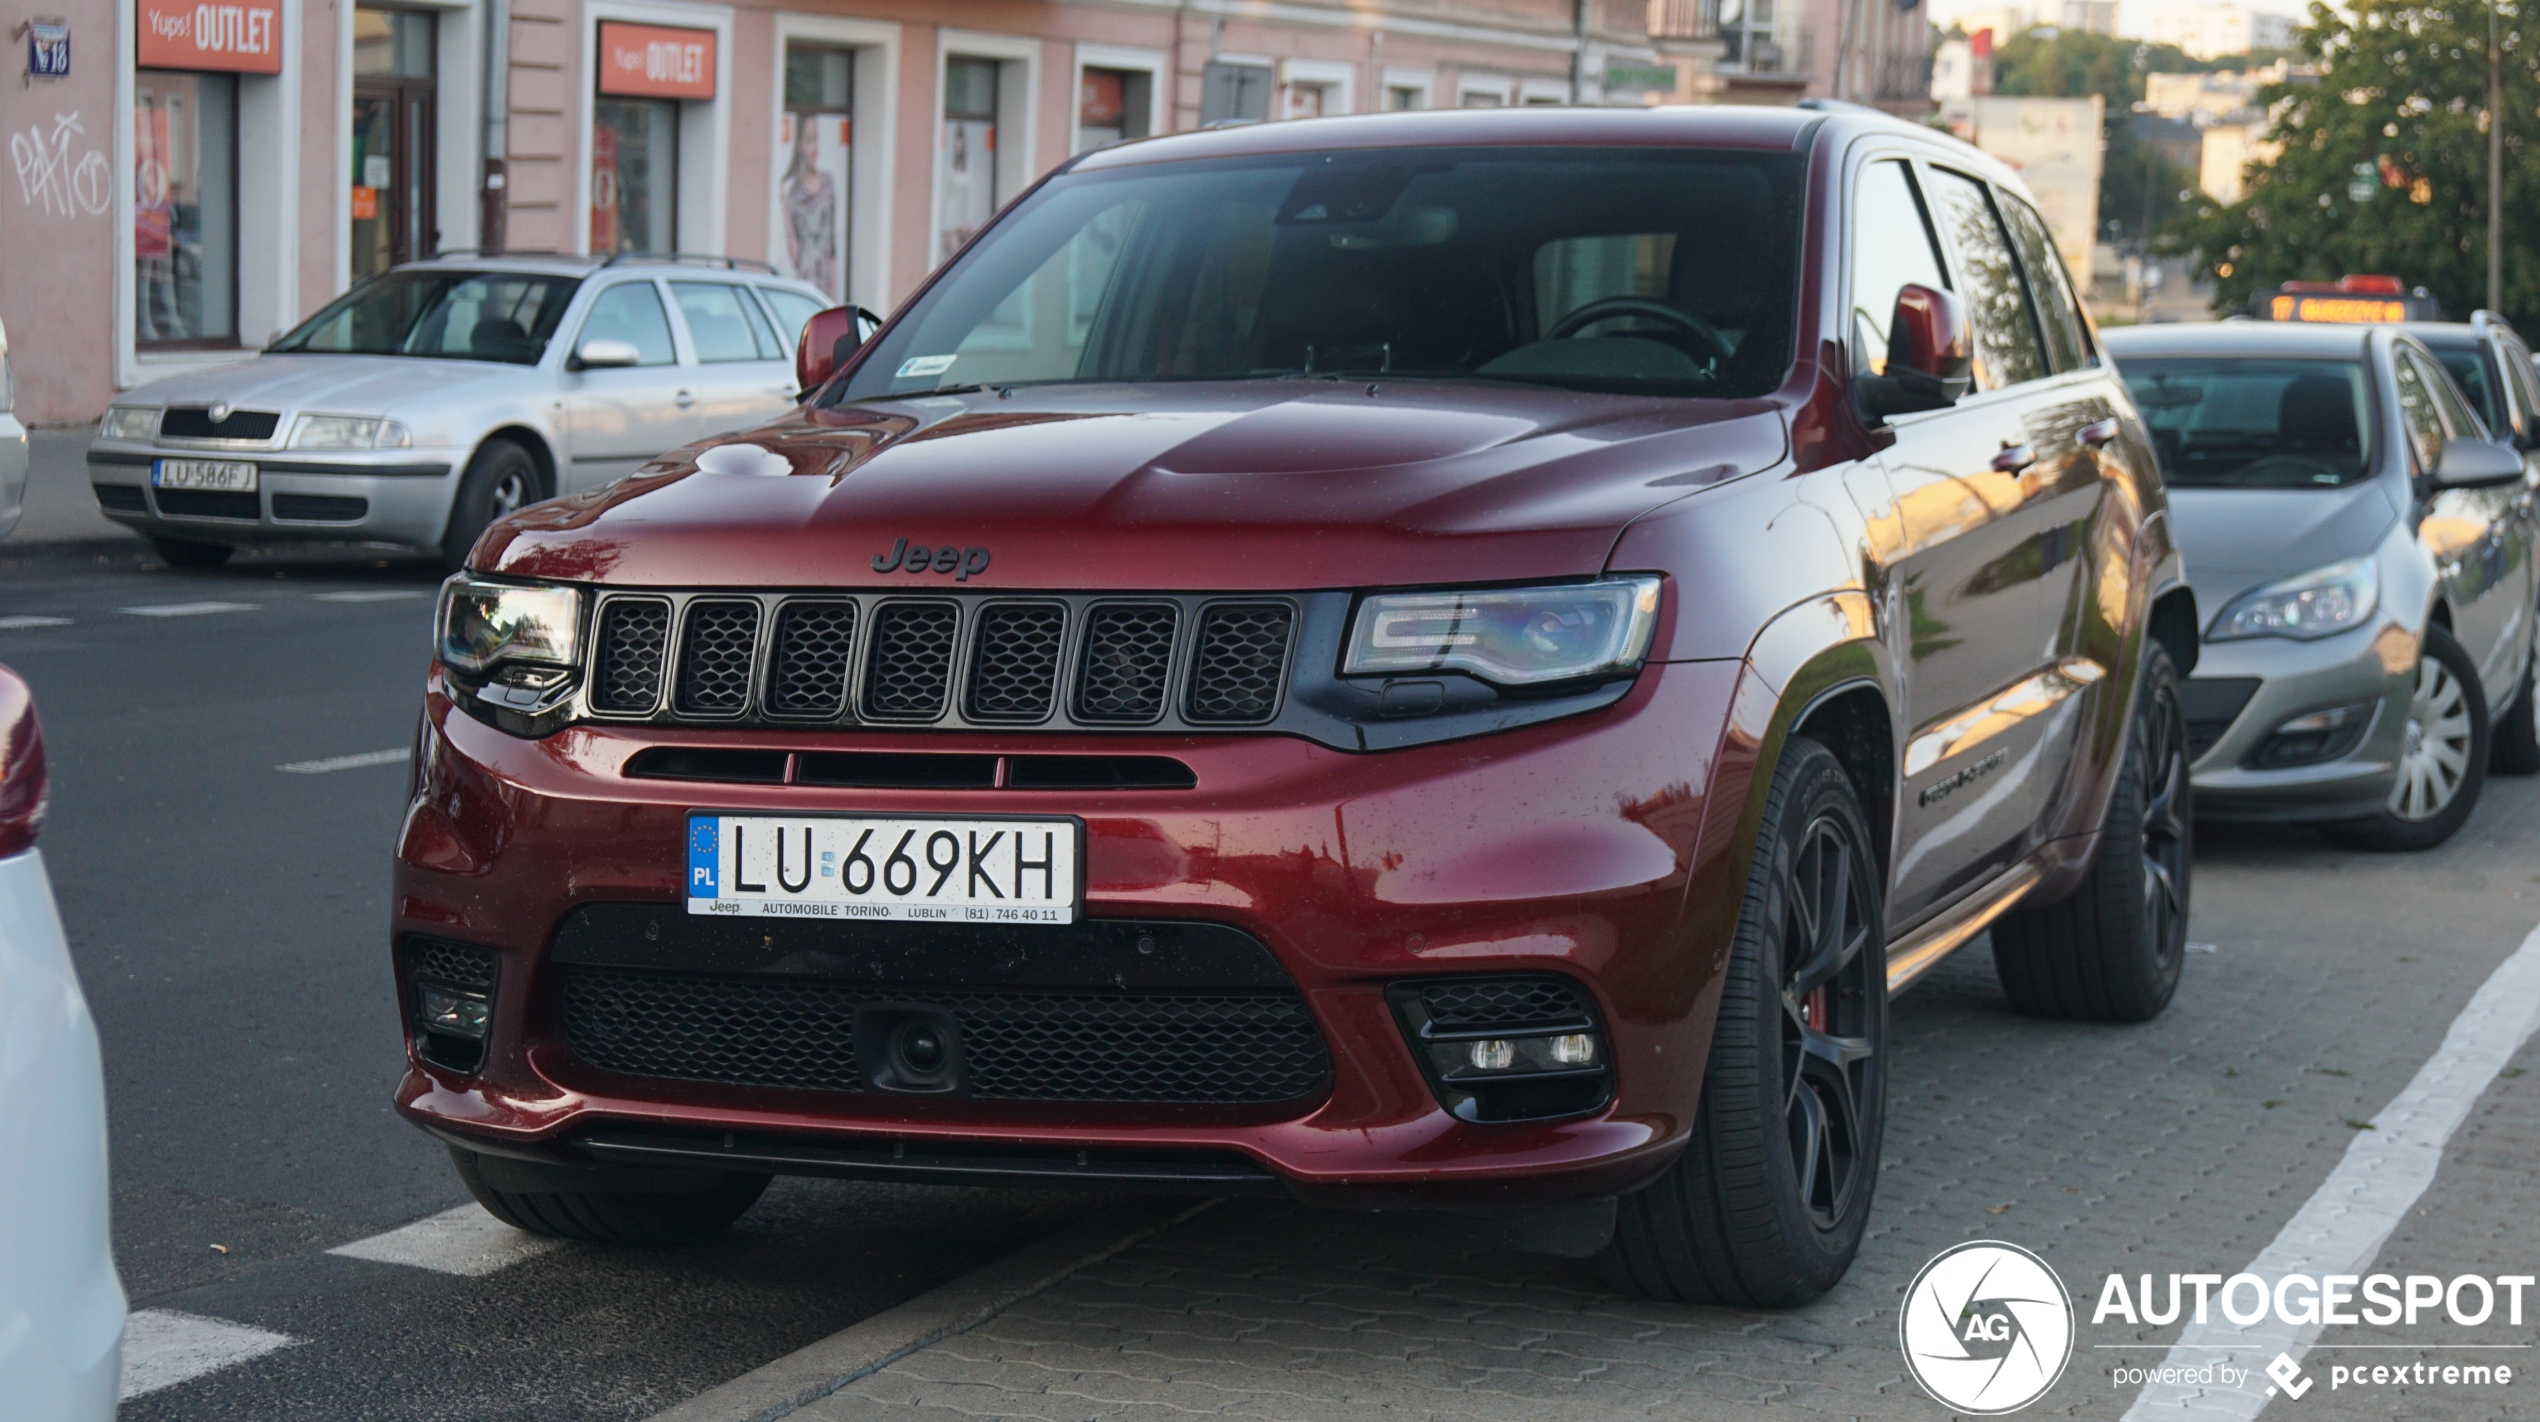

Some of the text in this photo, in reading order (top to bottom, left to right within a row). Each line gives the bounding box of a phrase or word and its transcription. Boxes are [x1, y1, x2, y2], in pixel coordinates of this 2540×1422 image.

[148, 3, 273, 54] Yups! OUTLET
[51, 40, 67, 73] 18
[646, 41, 704, 83] OUTLET
[164, 463, 189, 486] LU
[196, 463, 252, 488] 586FJ
[870, 538, 990, 582] Jeep
[694, 867, 715, 886] PL
[735, 825, 1053, 899] LU 669KH
[710, 900, 1057, 921] Jeep AUTOMOBILE TORINO LUBLIN (81) 746 40 11
